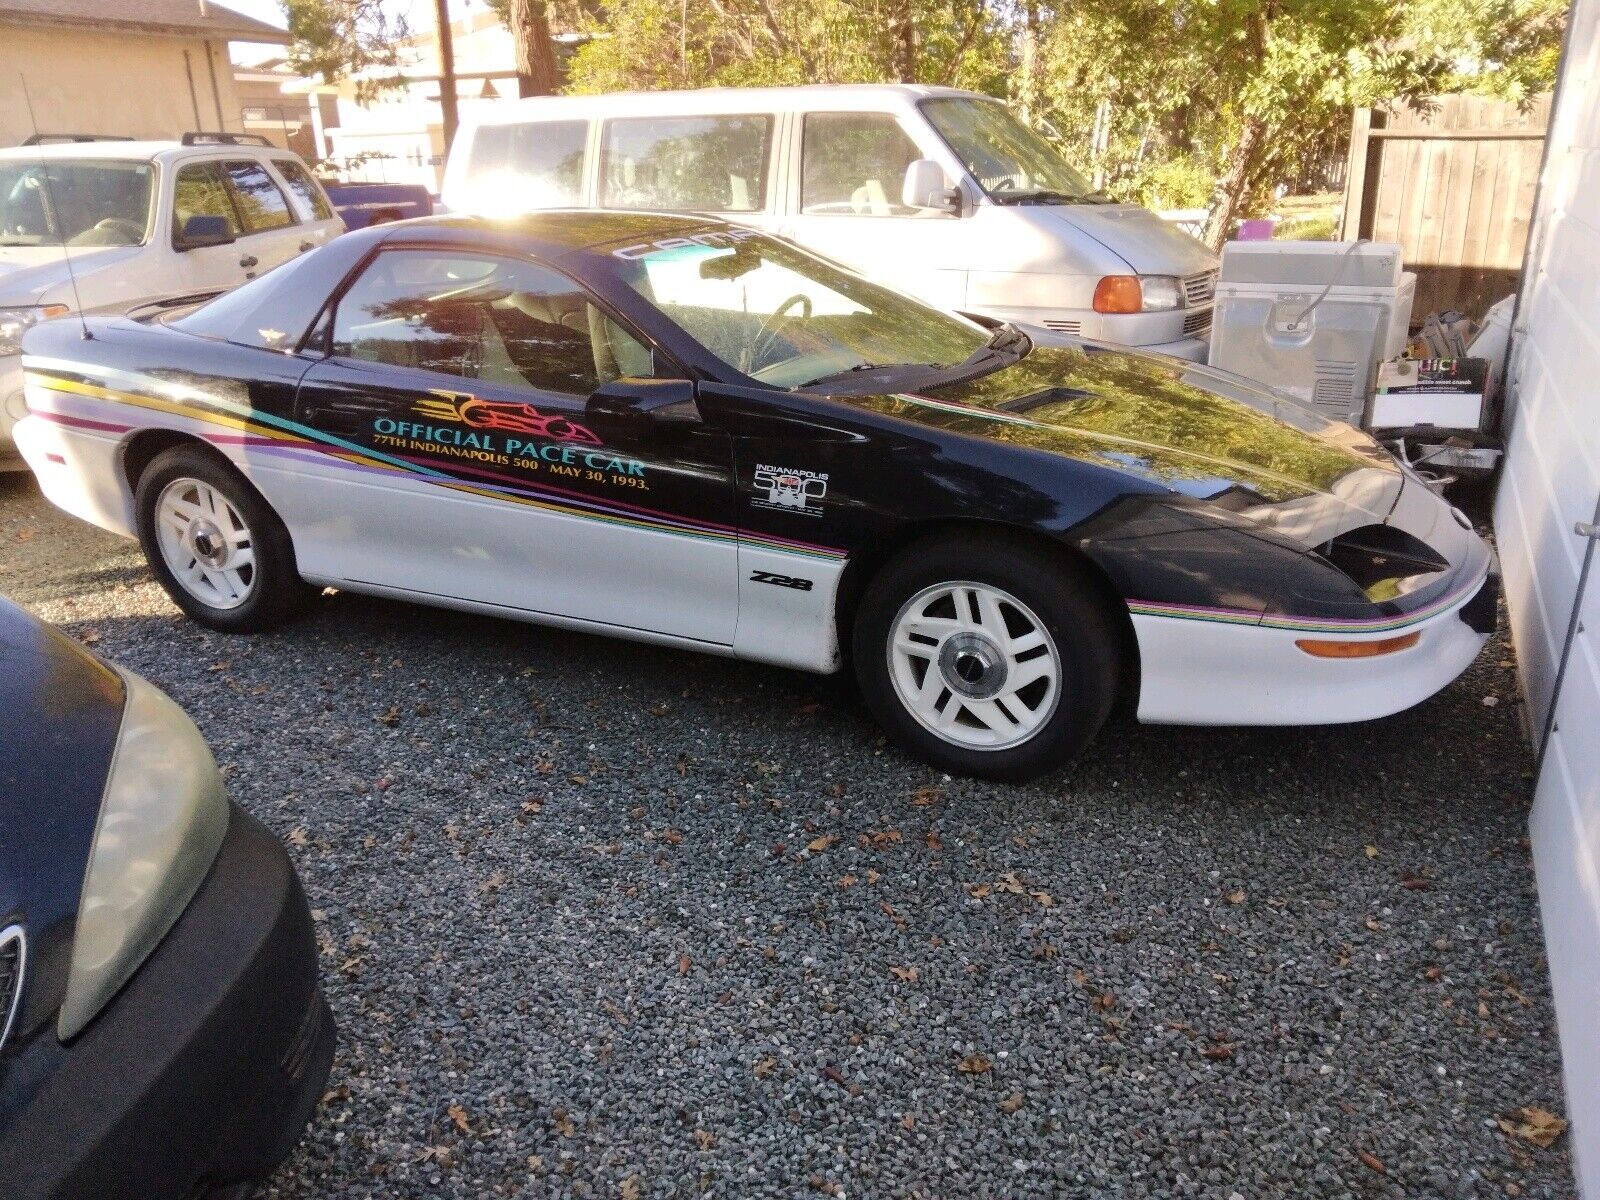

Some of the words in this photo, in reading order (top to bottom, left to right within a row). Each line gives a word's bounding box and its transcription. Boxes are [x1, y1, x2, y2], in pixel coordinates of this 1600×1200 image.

[373, 417, 496, 451] OFFICIAL
[506, 438, 577, 466] PACE
[585, 453, 646, 477] CAR
[373, 434, 406, 449] 77TH
[410, 440, 509, 466] INDIANAPOLIS
[513, 456, 538, 471] 500
[550, 462, 583, 479] MAY
[586, 469, 607, 484] 30,
[753, 470, 827, 499] 500
[756, 463, 829, 481] INDIANAPOLIS
[749, 569, 814, 592] Z28
